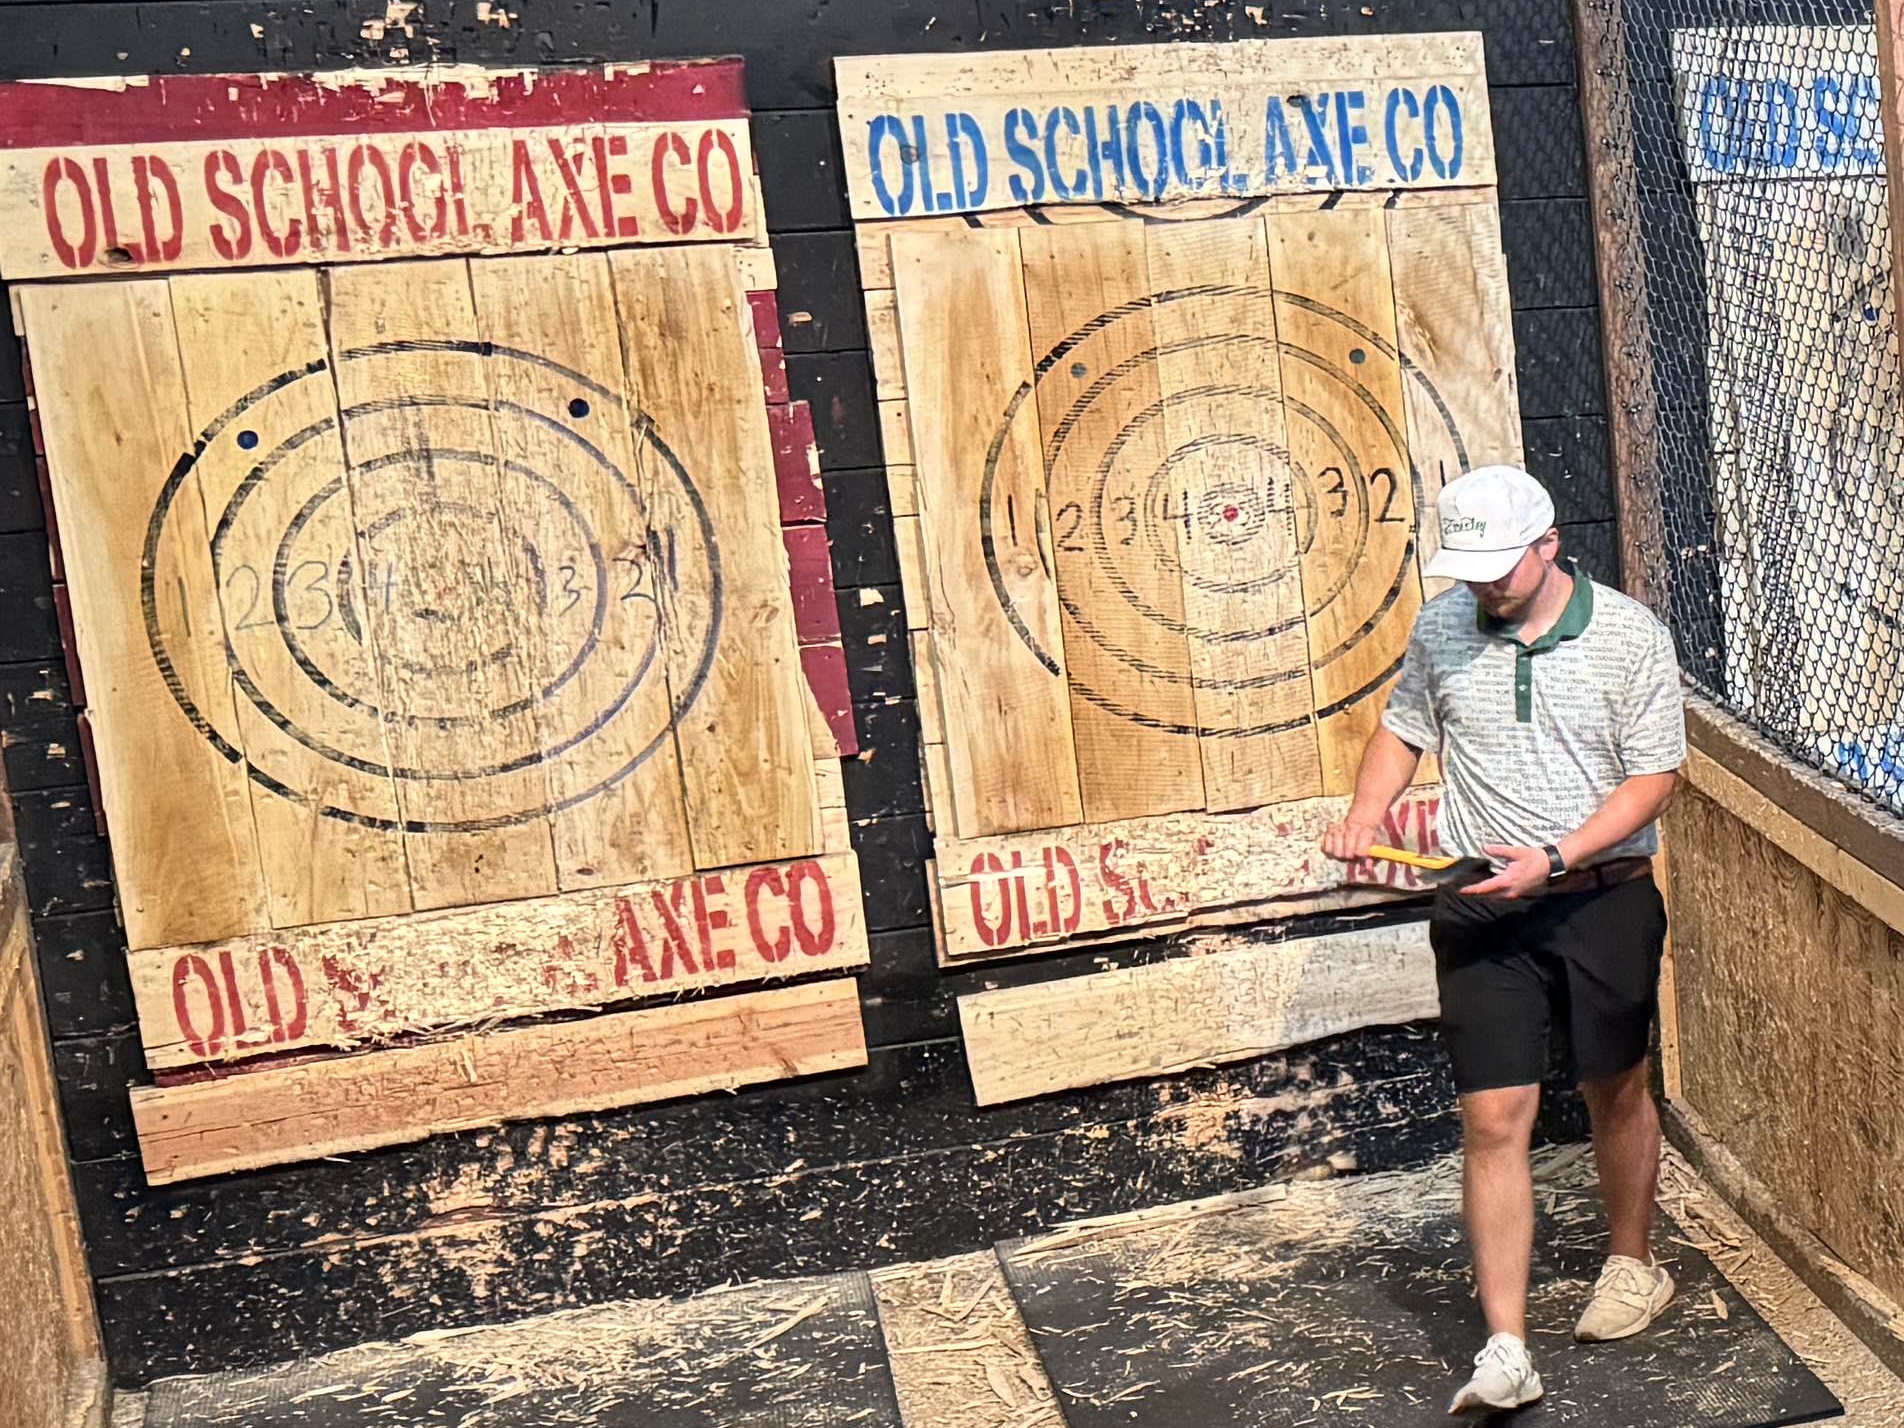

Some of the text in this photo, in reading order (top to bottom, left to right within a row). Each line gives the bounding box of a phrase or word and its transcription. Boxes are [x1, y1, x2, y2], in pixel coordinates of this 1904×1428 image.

[43, 128, 744, 269] OLD SCHOOL AXE CO
[868, 84, 1464, 217] OLD SCHOOL AXE CO
[1055, 501, 1086, 552] 2
[1114, 495, 1138, 546] 3
[1162, 487, 1191, 545] 4
[1317, 466, 1348, 518] 3
[1371, 467, 1406, 524] 2
[226, 563, 274, 631] 2
[286, 560, 334, 630] 3
[556, 564, 588, 616] 3
[612, 557, 656, 601] 2
[969, 844, 1082, 946] OLD
[172, 947, 308, 1057] OLD
[614, 874, 736, 986] AXE
[744, 859, 837, 962] CO
